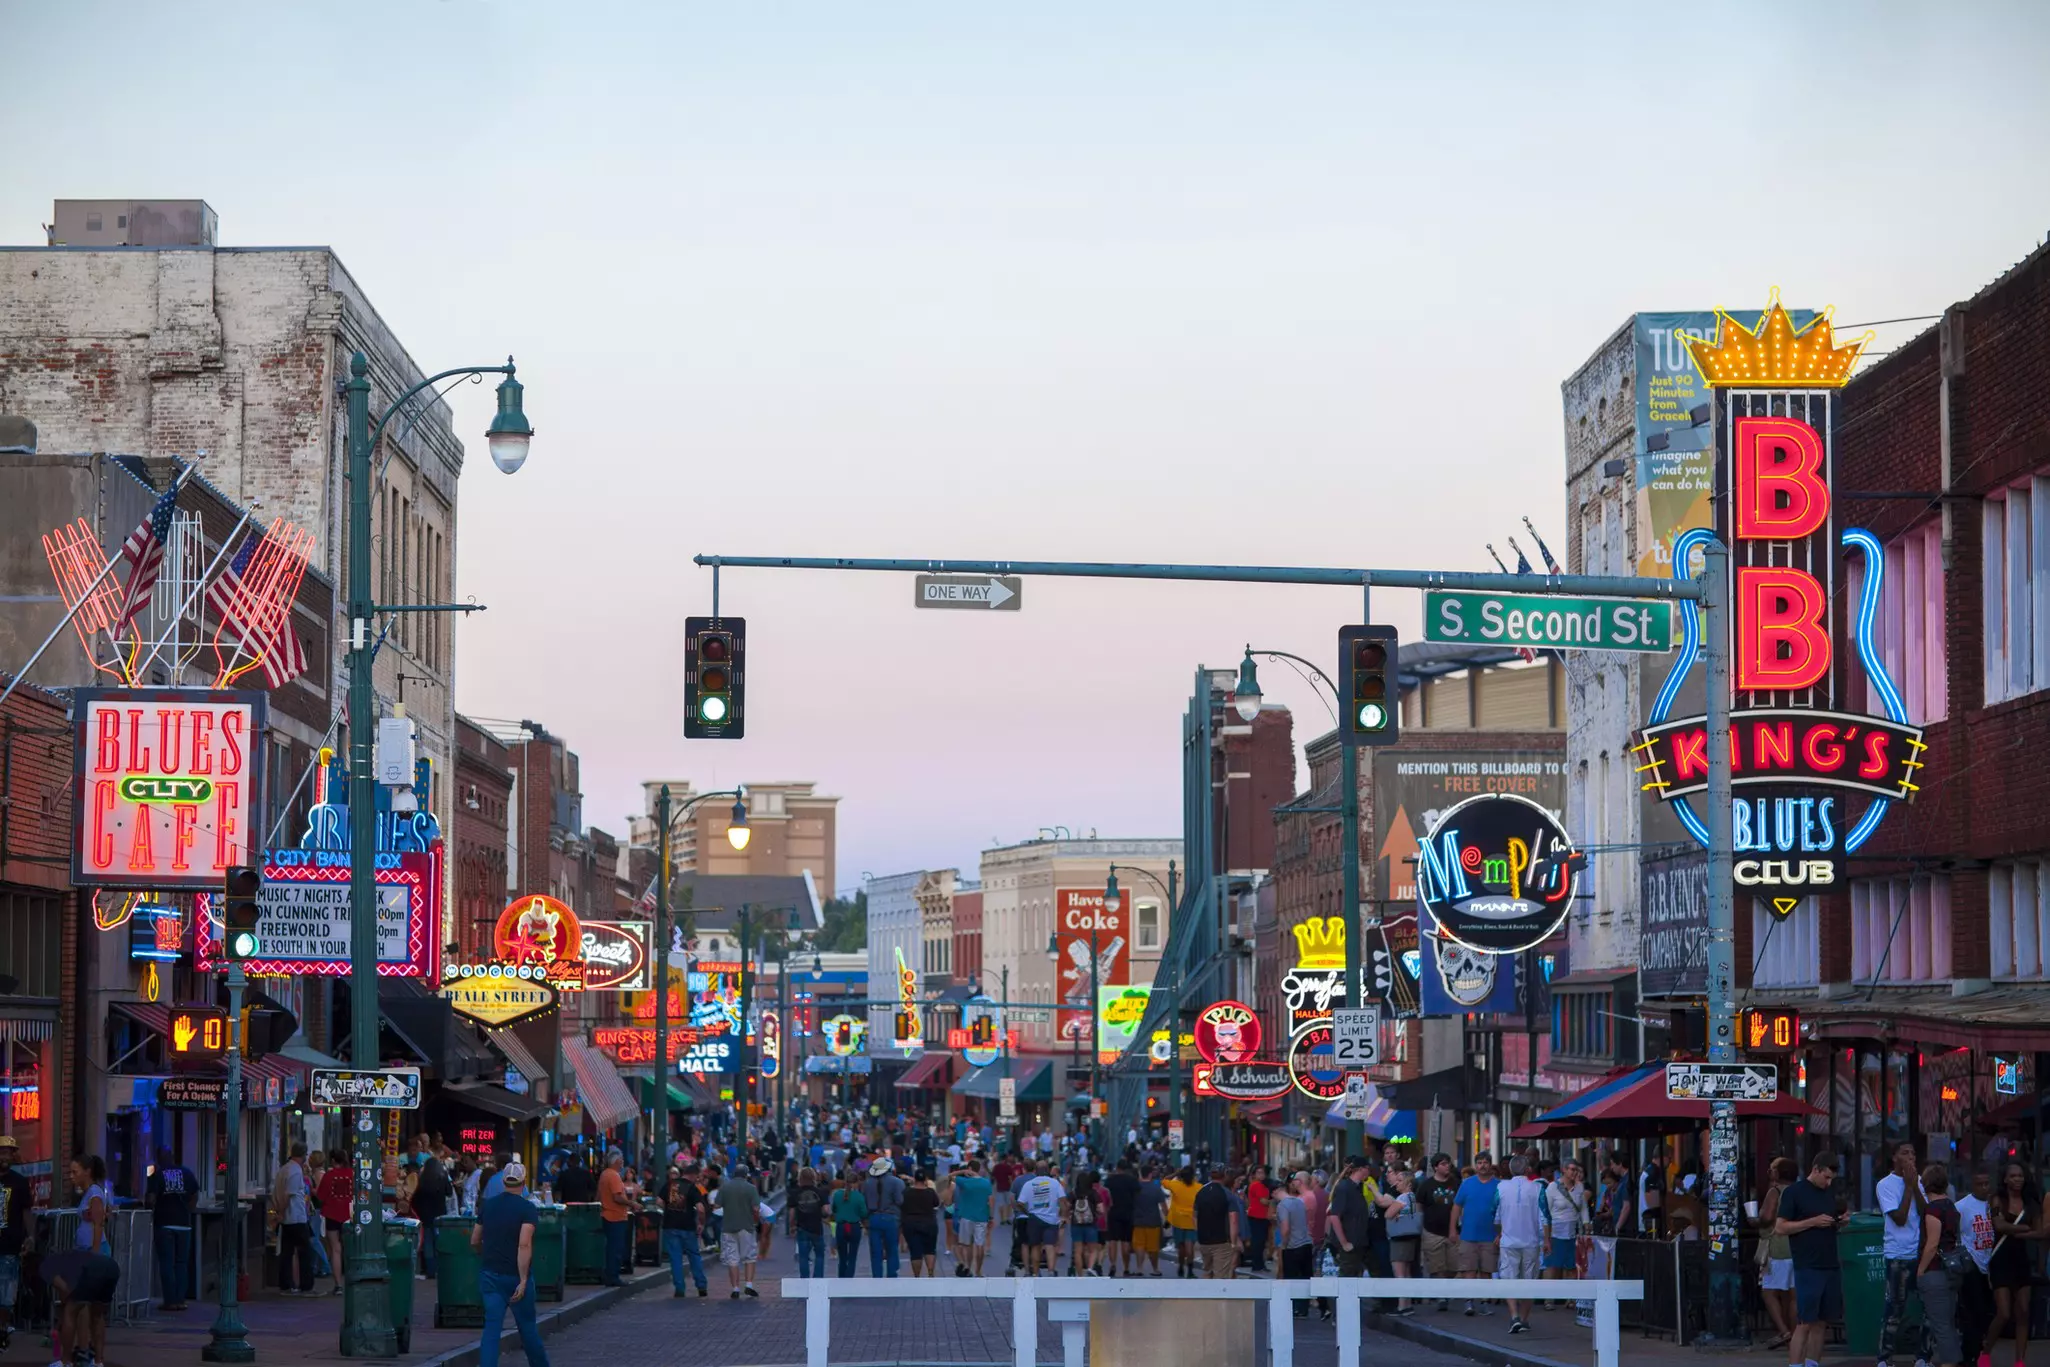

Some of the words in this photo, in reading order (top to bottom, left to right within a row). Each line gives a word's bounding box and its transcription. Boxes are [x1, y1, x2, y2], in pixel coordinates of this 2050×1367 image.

[1650, 376, 1672, 387] Just
[1676, 376, 1693, 386] 90
[1650, 388, 1695, 399] Minutes
[1650, 400, 1677, 410] from
[1652, 451, 1702, 464] imagine
[1652, 464, 1684, 476] what
[1685, 467, 1708, 478] you
[1735, 417, 1831, 538] B
[1652, 480, 1675, 491] can
[1677, 479, 1693, 490] do
[928, 585, 957, 599] ONE
[962, 586, 991, 600] WAY
[1439, 598, 1470, 638] S.
[1480, 600, 1602, 643] Second
[1611, 606, 1658, 646] St.
[1736, 567, 1832, 690] B
[94, 709, 243, 775] BLUES
[1670, 721, 1890, 781] KING'S
[1397, 762, 1449, 775] MENTION
[1452, 763, 1478, 775] THIS
[1481, 763, 1541, 775] BILLBOARD
[1545, 763, 1559, 775] TO
[1444, 777, 1484, 792] FREE
[1486, 777, 1537, 793] COVER
[92, 780, 239, 870] CAFE
[1732, 797, 1835, 852] BLUES
[274, 851, 312, 867] CITY
[316, 852, 352, 867] BAN
[1733, 860, 1835, 885] CLUB
[257, 889, 290, 903] MUSIC
[294, 890, 301, 903] 7
[304, 890, 342, 904] NIGHTS
[1068, 893, 1104, 907] Have
[276, 907, 330, 921] CUNNING
[333, 908, 352, 921] TRI
[1066, 910, 1119, 931] Coke
[261, 923, 330, 938] FREEWORLD
[1459, 923, 1483, 932] Everything
[271, 940, 303, 954] SOUTH
[306, 940, 316, 954] IN
[320, 941, 346, 955] YOUR
[1641, 928, 1683, 971] COMPANY
[1685, 926, 1709, 968] STOR
[445, 991, 488, 1003] BEALE
[494, 991, 546, 1003] STREET
[1203, 1007, 1252, 1026] PIG
[1295, 1010, 1318, 1019] HALL
[1319, 1010, 1332, 1019] OF
[1336, 1014, 1375, 1024] SPEED
[204, 1018, 221, 1050] 10
[596, 1030, 639, 1044] KING'S
[1341, 1026, 1371, 1036] LIMIT
[1774, 1016, 1790, 1046] 10
[1337, 1038, 1375, 1059] 25
[679, 1058, 724, 1073] HALL
[1230, 1066, 1291, 1084] Schwab
[163, 1082, 186, 1091] First
[187, 1082, 221, 1092] Chance
[166, 1091, 181, 1101] For
[182, 1092, 189, 1101] A
[191, 1092, 217, 1102] Drink
